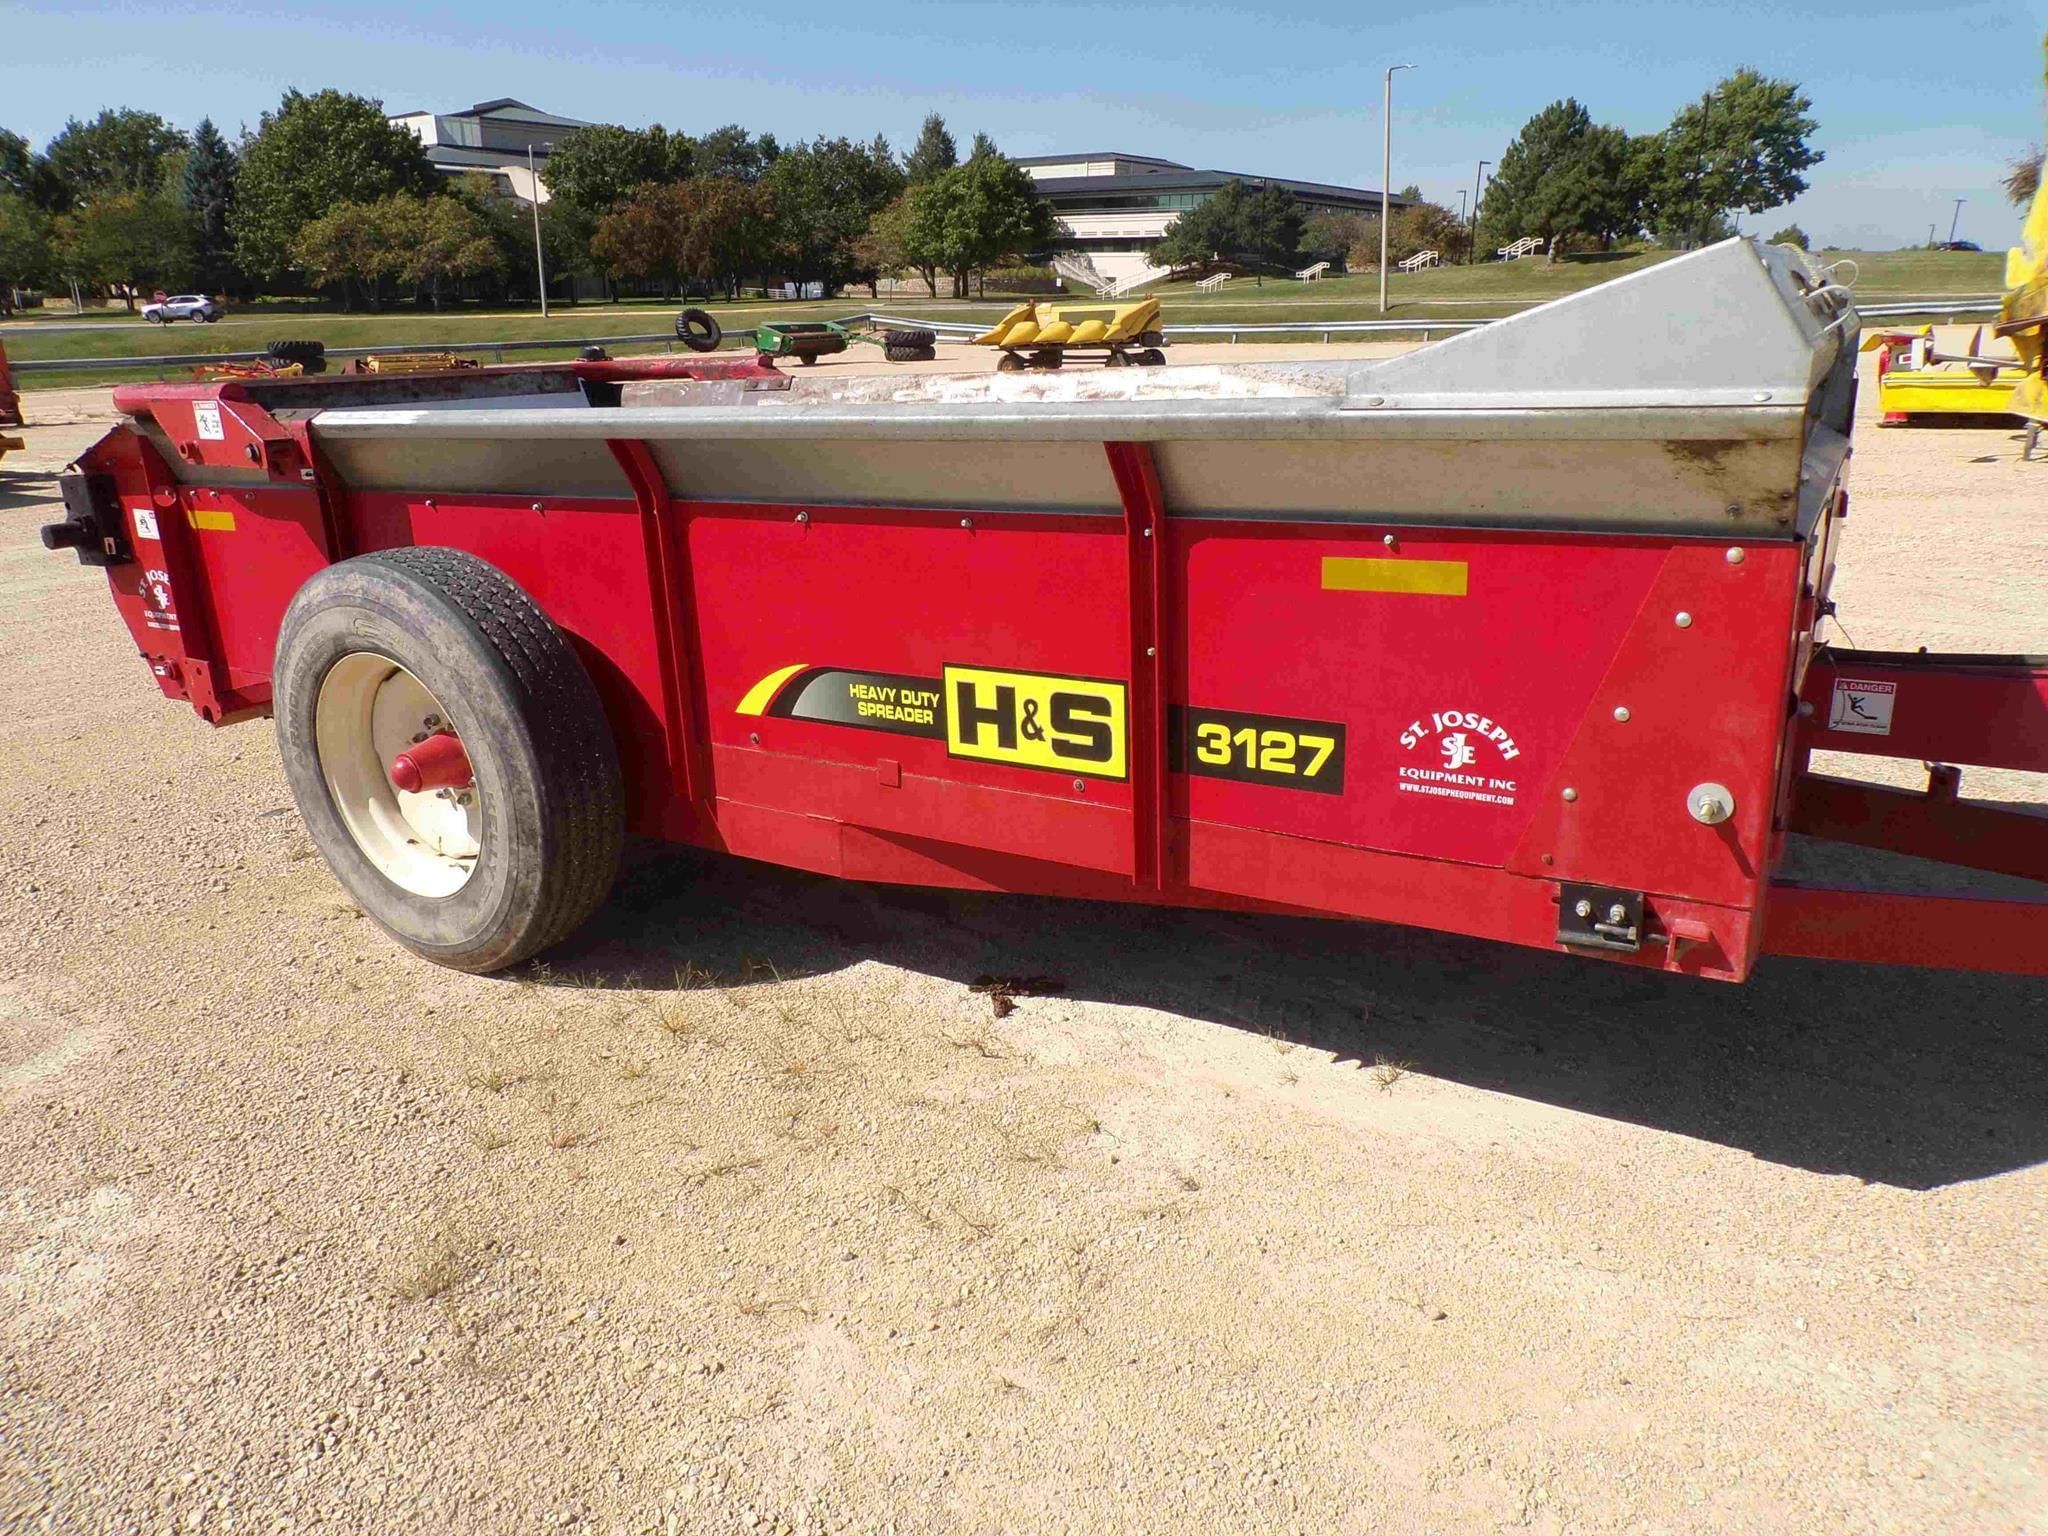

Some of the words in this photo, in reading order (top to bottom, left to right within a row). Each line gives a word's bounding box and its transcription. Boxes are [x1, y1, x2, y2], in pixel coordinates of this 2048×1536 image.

[849, 683, 896, 702] HEAVY
[901, 689, 940, 708] DUTY
[1849, 682, 1893, 693] DANGER
[857, 701, 934, 725] SPREADER
[956, 681, 1113, 763] H&S
[1399, 720, 1430, 750] ST.
[1431, 710, 1521, 761] JOSEPH
[1197, 723, 1336, 777] 3127
[1399, 767, 1485, 787] EQUIPMENT
[1488, 779, 1517, 791] INC
[1399, 782, 1515, 806] WWW.STJOSEPHEQUIPMENT.COM
